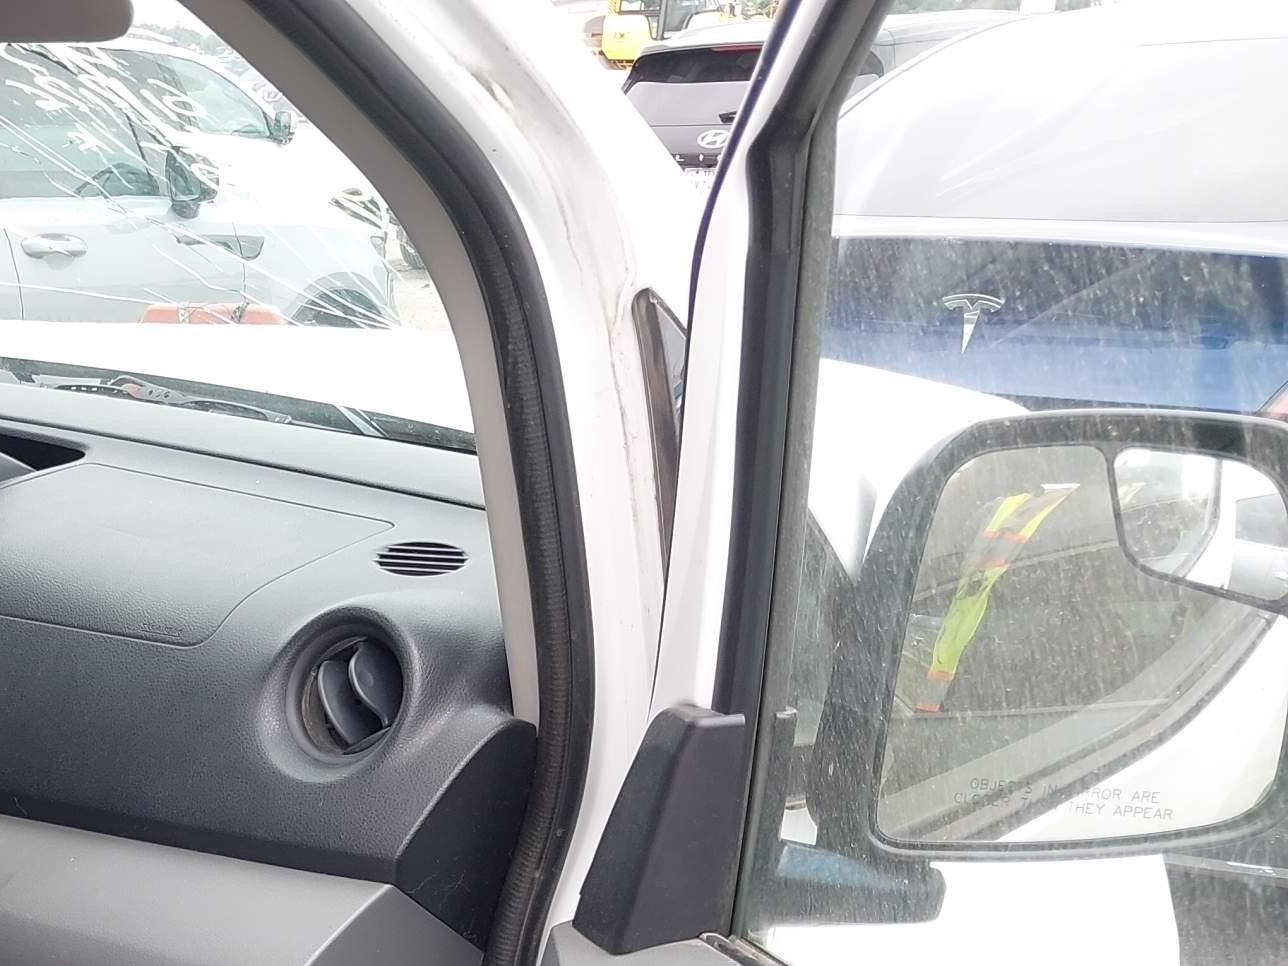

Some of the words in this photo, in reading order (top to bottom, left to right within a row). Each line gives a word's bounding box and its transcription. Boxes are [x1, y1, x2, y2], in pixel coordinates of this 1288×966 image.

[1131, 791, 1160, 804] ARE
[1069, 800, 1106, 815] THEY
[1112, 804, 1174, 820] APPEAR
